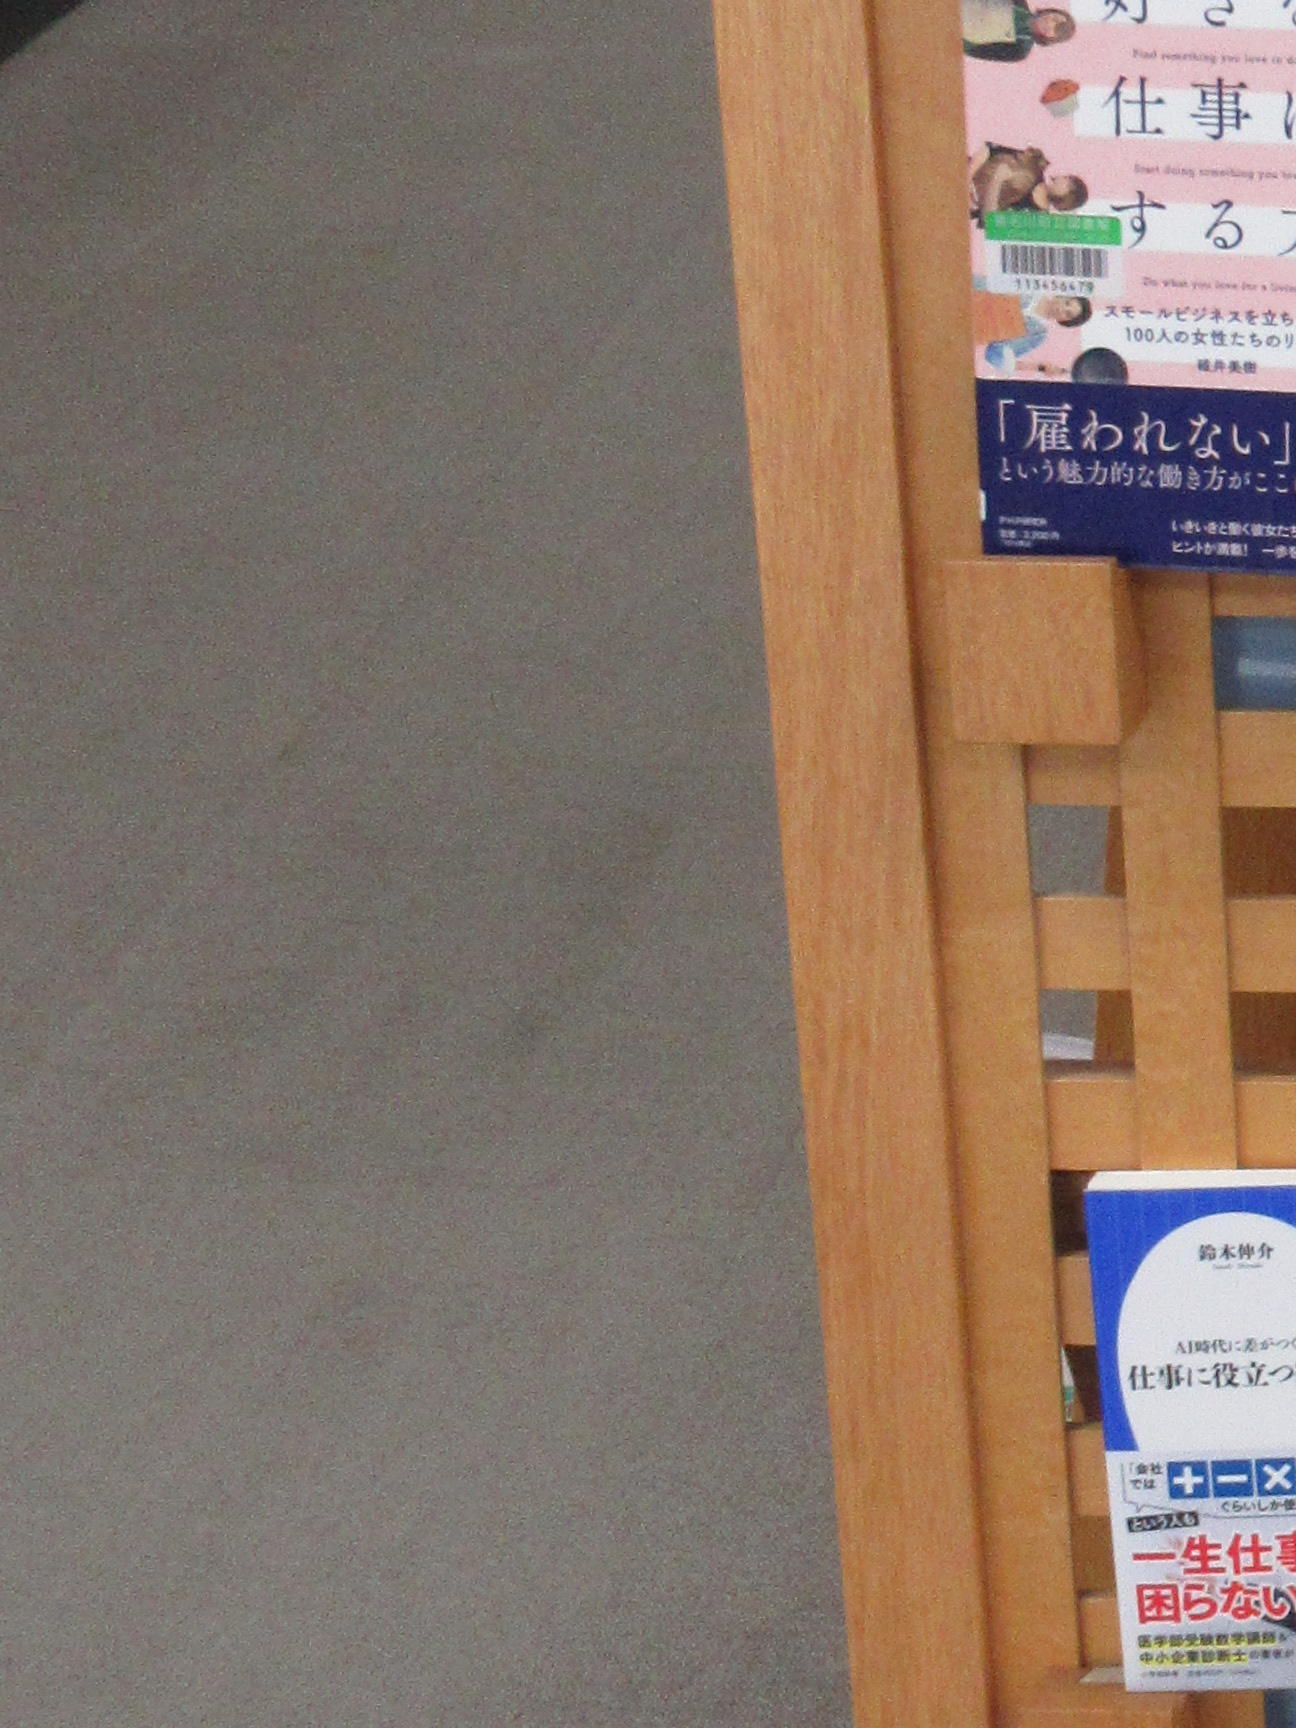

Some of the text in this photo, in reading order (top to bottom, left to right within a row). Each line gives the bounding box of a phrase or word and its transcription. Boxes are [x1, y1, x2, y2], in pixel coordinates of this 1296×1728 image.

[999, 399, 1291, 465] 「雇われない」
[1130, 1515, 1198, 1531] という人も
